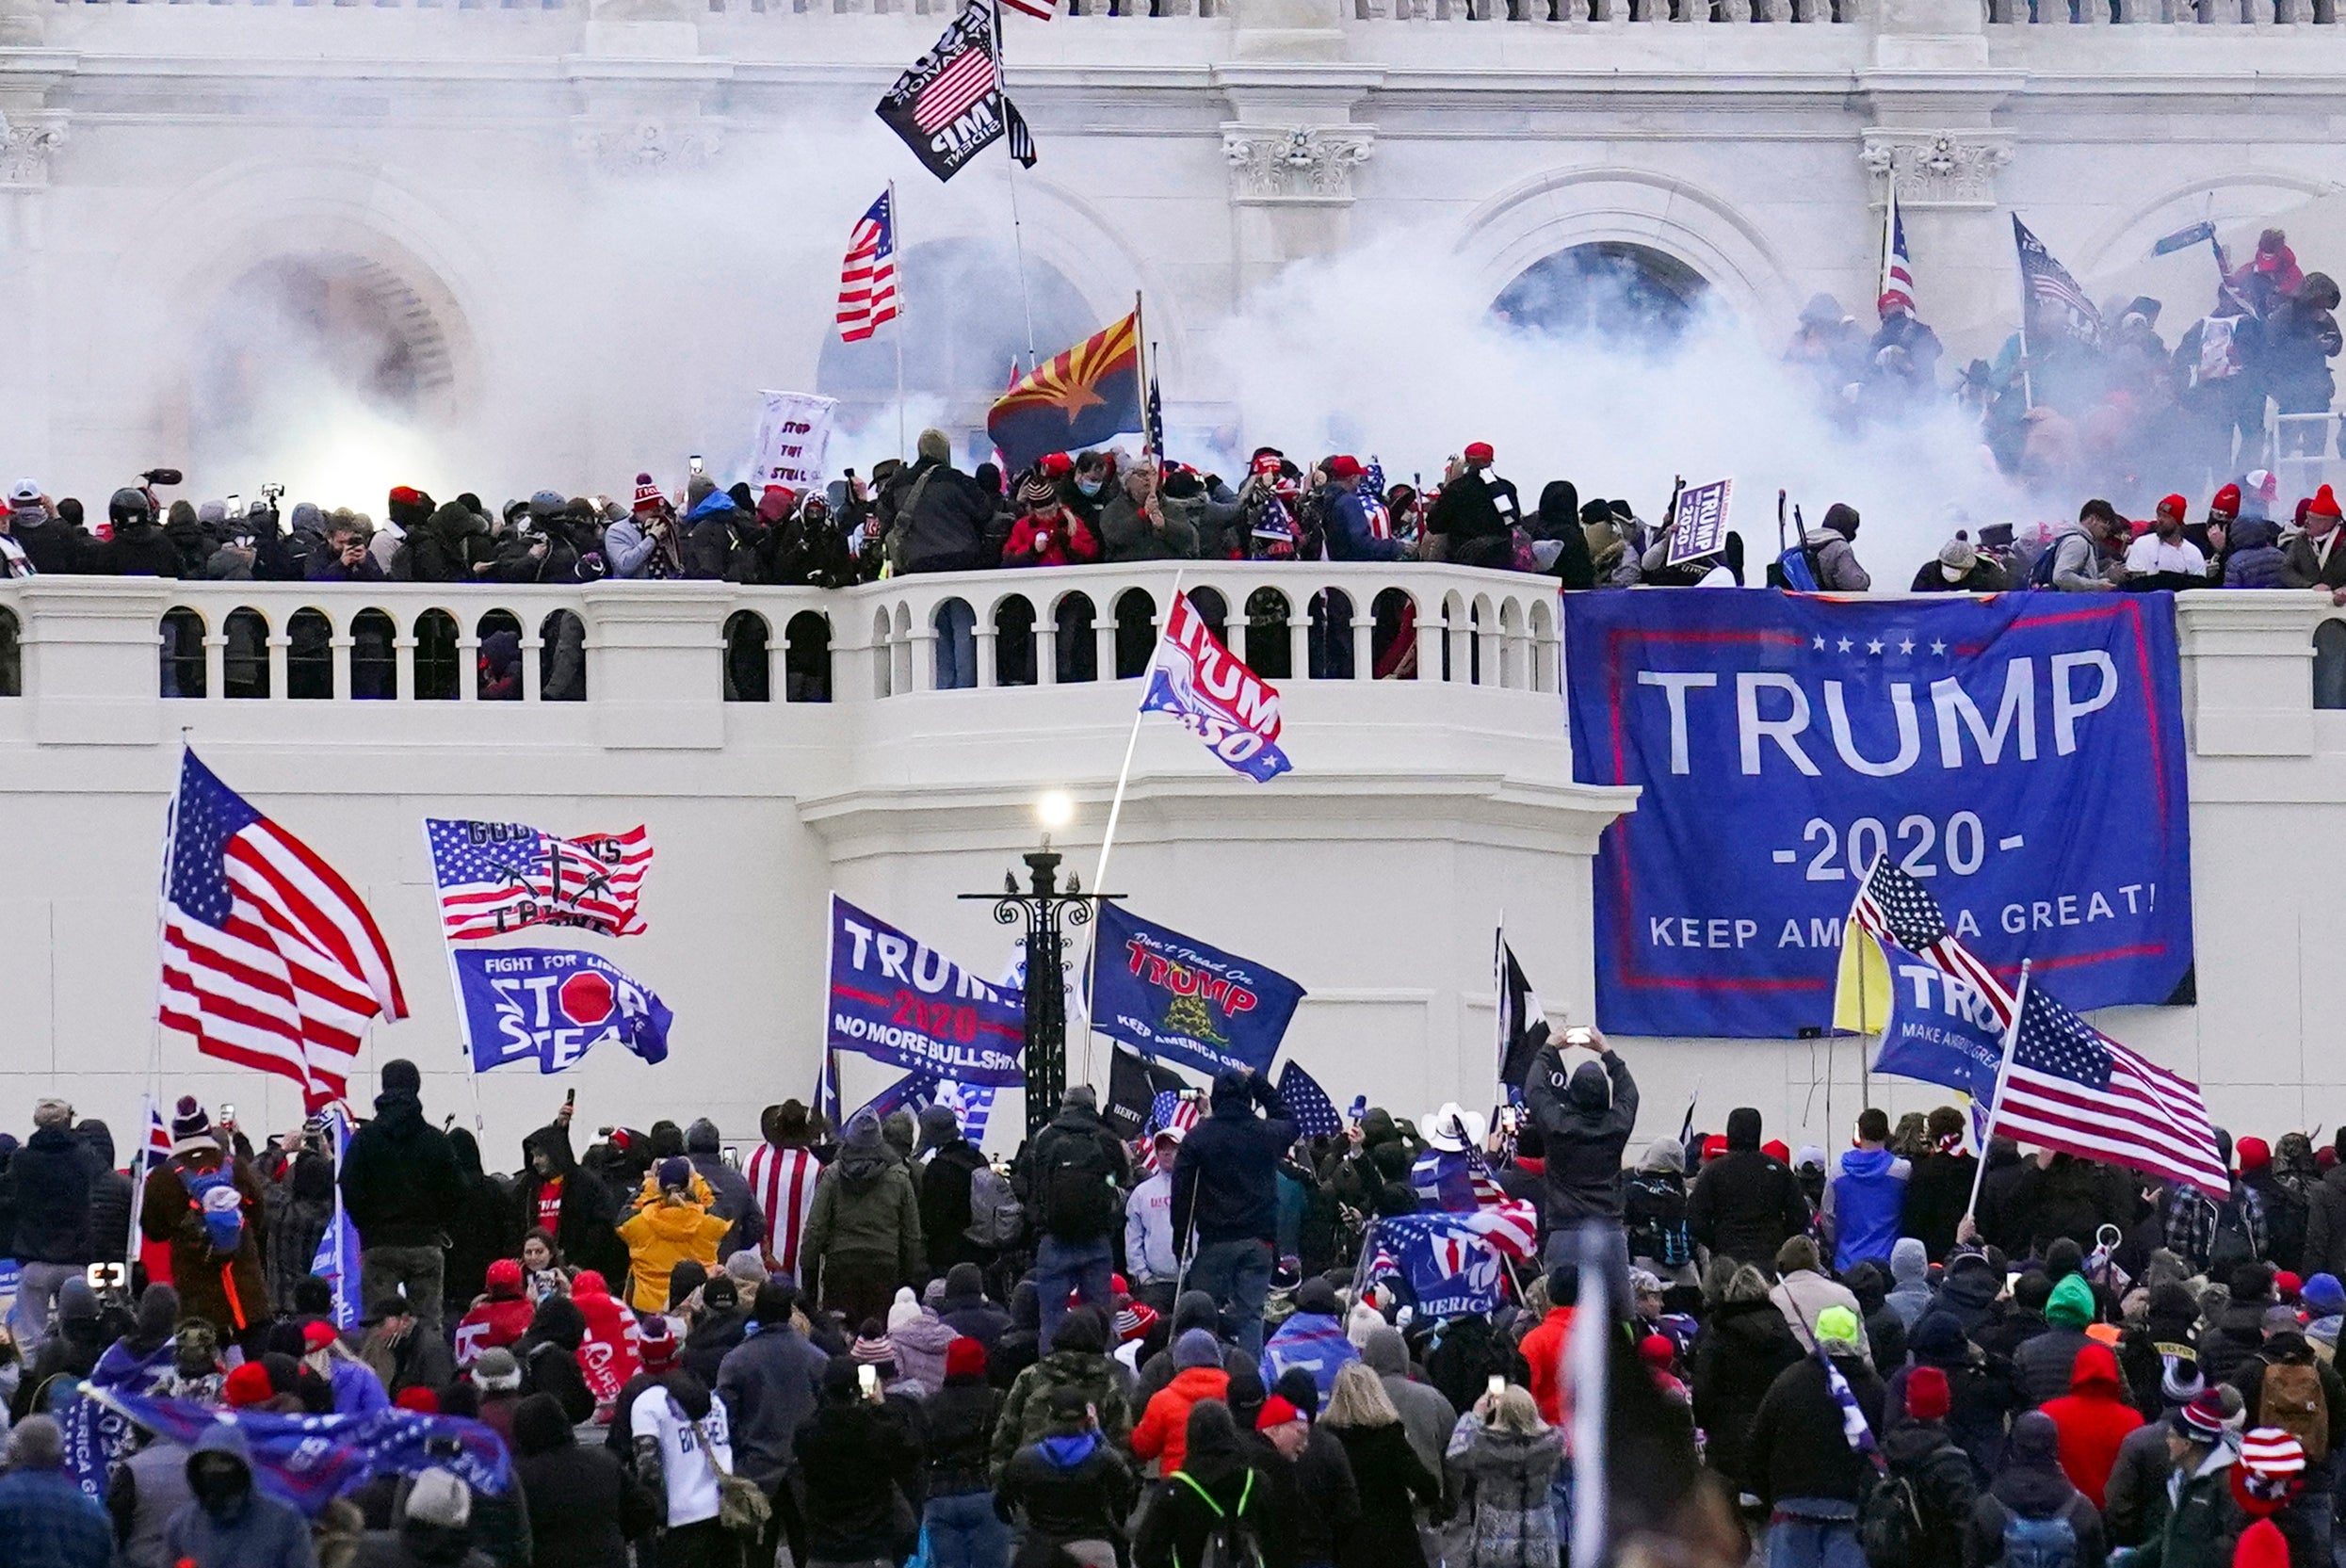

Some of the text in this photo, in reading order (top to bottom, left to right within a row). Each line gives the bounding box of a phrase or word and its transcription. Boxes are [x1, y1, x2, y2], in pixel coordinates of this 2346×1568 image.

[782, 421, 811, 434] STOP
[1677, 505, 1692, 545] 2020
[1696, 484, 1722, 550] TRUMP
[1637, 649, 2118, 777] TRUMP
[1650, 916, 1758, 948] KEEP
[2000, 882, 2157, 934] GREAT!
[485, 956, 534, 973] FIGHT
[542, 954, 576, 969] FOR
[845, 919, 1025, 1009] TRUM
[1126, 939, 1258, 1018] TRUMP
[1134, 931, 1254, 986] Don't Tread On
[835, 1013, 867, 1039] NO
[866, 1022, 928, 1057] MORE
[1117, 1014, 1153, 1038] KEEP
[1155, 1034, 1218, 1063] AMERICA
[1902, 1022, 1941, 1044] MAKE
[1971, 1043, 2002, 1073] GREA
